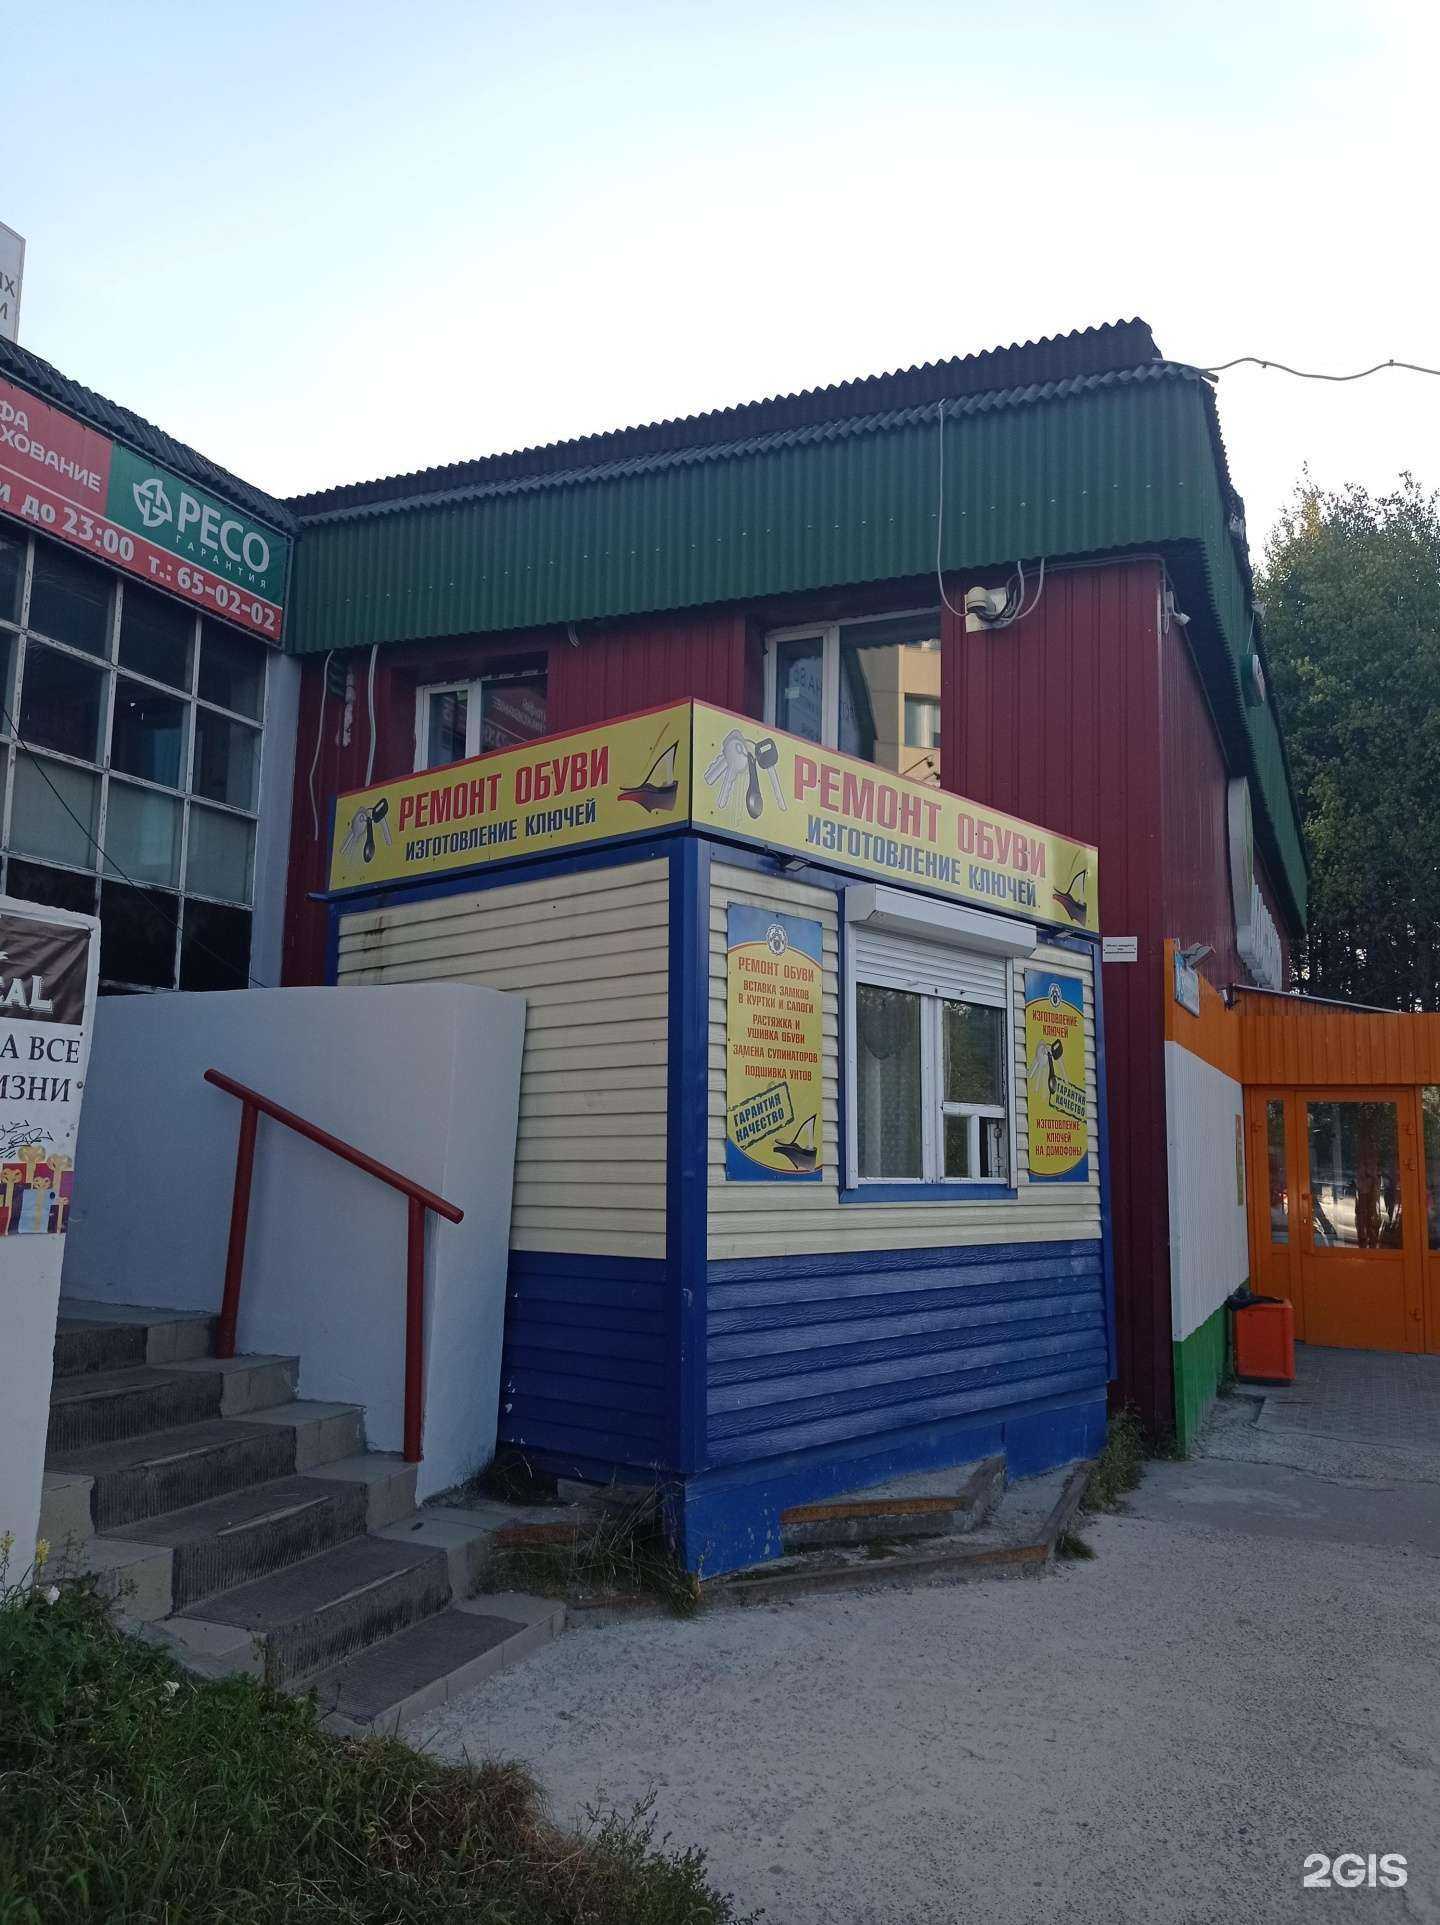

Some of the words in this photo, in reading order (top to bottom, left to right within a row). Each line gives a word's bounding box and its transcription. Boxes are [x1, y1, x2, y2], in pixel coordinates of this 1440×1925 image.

[177, 492, 269, 573] РЕСО
[62, 507, 135, 562] 23:00
[177, 567, 275, 631] 65-02-02
[176, 534, 267, 589] ГАРАНТИЯ
[399, 773, 502, 832] РЕМОНТ
[515, 746, 609, 806] ОБУВИ
[405, 819, 518, 862] ИЗГОТОВЛЕНИЕ
[525, 798, 597, 837] КЛЮЧЕЙ
[794, 754, 942, 843] РЕМОНТ
[957, 812, 1046, 879] ОБУВИ
[807, 814, 961, 886] ИЗГОТОВЛЕНИЕ
[968, 863, 1037, 909] КЛЮЧЕЙ
[738, 957, 780, 976] РЕМОНТ
[784, 964, 814, 982] ОБУВИ
[0, 975, 53, 1013] AL
[743, 979, 777, 995] ВСТАВКА
[779, 985, 810, 1000] ЗАМКОВ
[738, 993, 743, 1003] В
[747, 994, 776, 1009] КУРТКИ
[786, 1000, 814, 1014] САПОГИ
[747, 1027, 779, 1041] УШИВКА
[781, 1031, 805, 1044] ОБУВИ
[752, 1014, 793, 1030] РАСТЯЖКА
[795, 1019, 800, 1030] И
[29, 1035, 80, 1064] ВСЕ
[733, 1044, 765, 1058] ЗАМЕНА
[767, 1047, 818, 1063] СУПИНАТОРОВ
[745, 1065, 787, 1079] ПОДШИВКА
[789, 1069, 812, 1081] УНТОВ
[1055, 1094, 1086, 1117] КАЧЕСТВО
[1056, 1083, 1087, 1106] ГАРАНТИЯ
[734, 1093, 782, 1128] ГАРАНТИЯ
[735, 1107, 785, 1143] КАЧЕСТВО
[1036, 1119, 1081, 1131] ИЗГОТОВЛЕНИЕ
[1035, 1145, 1044, 1156] НА
[1046, 1146, 1082, 1157] ДОМОФОНЫ
